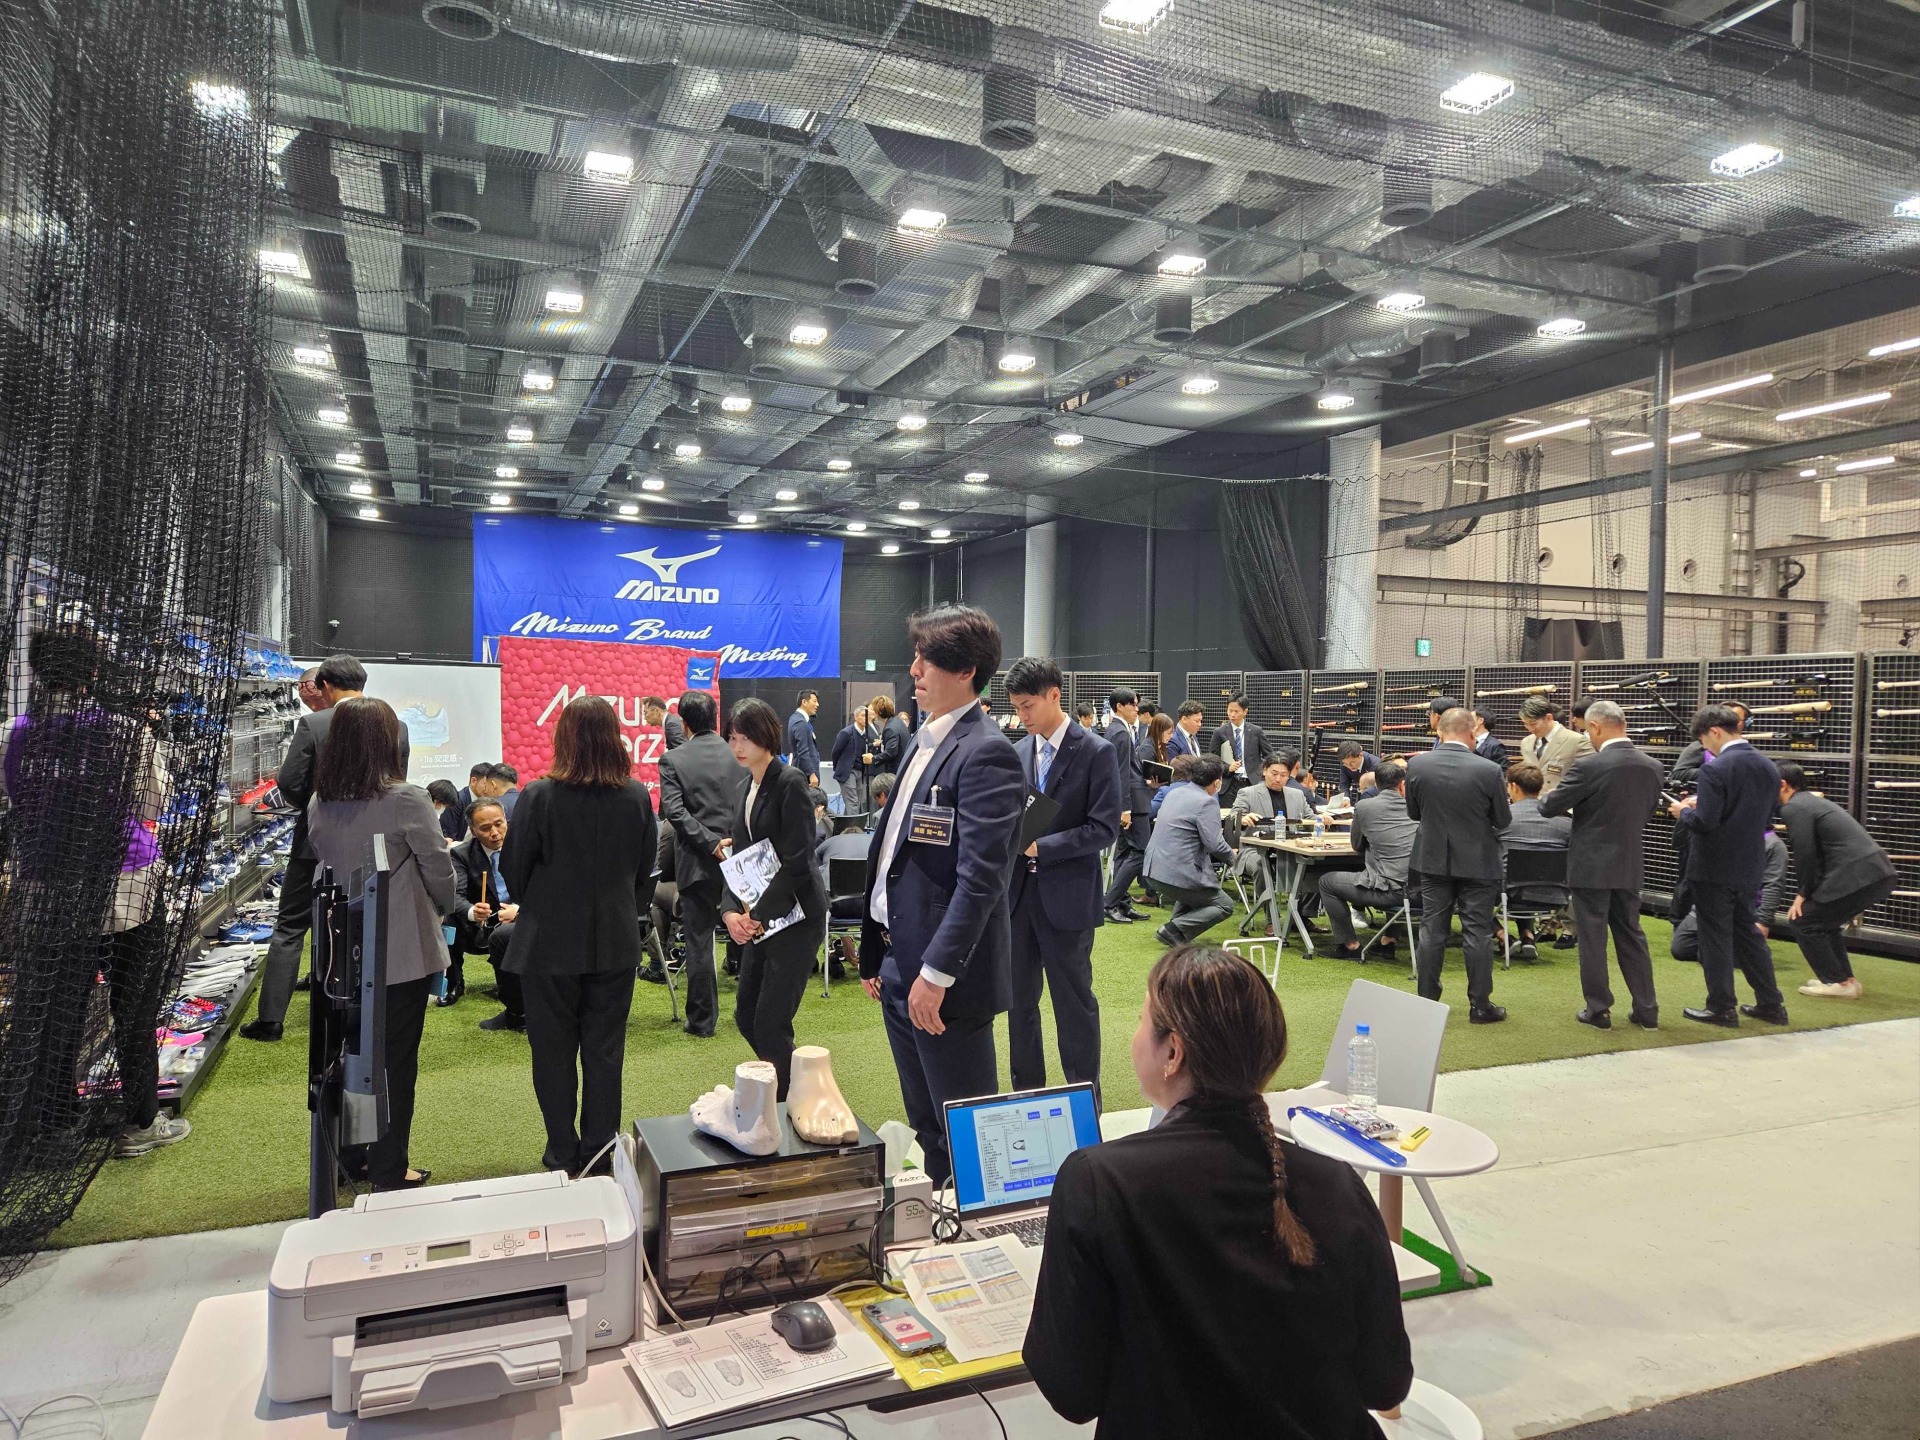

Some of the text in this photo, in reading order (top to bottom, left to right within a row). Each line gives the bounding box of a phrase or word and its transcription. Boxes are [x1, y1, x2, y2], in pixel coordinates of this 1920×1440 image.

[509, 611, 713, 641] Mizuno Brand
[717, 643, 810, 669] Meeting
[905, 1204, 925, 1217] 55th
